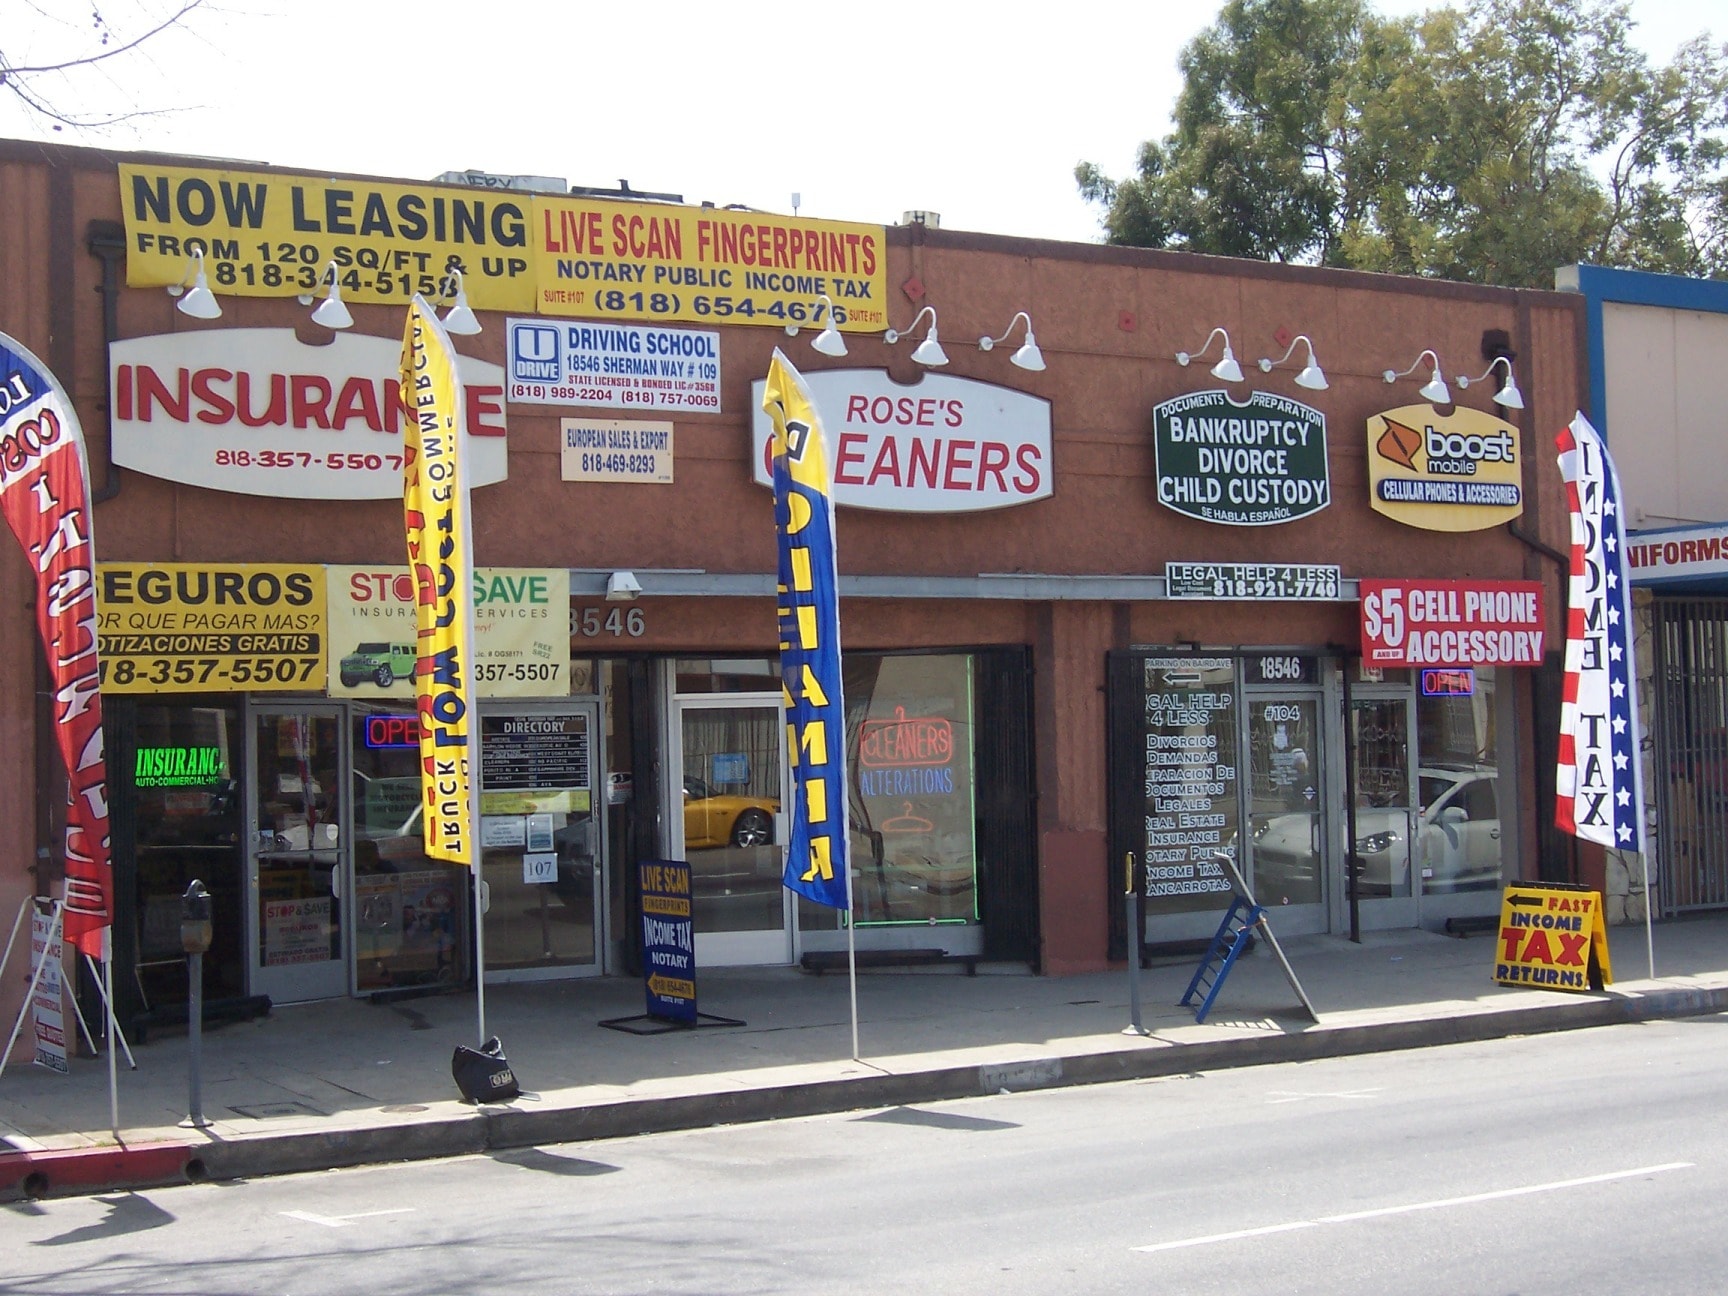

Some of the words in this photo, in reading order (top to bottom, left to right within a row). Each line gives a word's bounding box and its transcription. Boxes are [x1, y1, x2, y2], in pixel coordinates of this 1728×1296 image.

[131, 175, 268, 229] NOW
[291, 185, 527, 247] LEASING
[544, 209, 604, 256] LIVE
[612, 213, 682, 261] SCAN
[697, 219, 877, 276] FINGERPRINTS
[137, 233, 241, 260] FROM
[257, 242, 320, 264] 120
[334, 246, 432, 272] SQ/FT
[445, 254, 467, 275] &
[482, 257, 528, 278] UP
[215, 262, 458, 297] 818-344-5158
[557, 259, 646, 283] NOTARY
[655, 266, 733, 289] PUBLIC
[745, 271, 826, 296] INCOME
[832, 278, 872, 299] TAX
[543, 289, 566, 303] SUITE
[567, 290, 585, 305] #107
[594, 289, 681, 314] (818)
[693, 295, 847, 325] 654-4676
[848, 309, 867, 322] SUITE
[868, 311, 882, 324] #107
[568, 327, 641, 353] DRIVING
[646, 334, 716, 357] SCHOOL
[516, 360, 559, 379] DRIVE
[567, 354, 600, 372] 18546
[603, 357, 657, 376] SHERMAN
[660, 360, 684, 378] WAY
[699, 363, 717, 379] 109
[568, 375, 593, 385] STATE
[594, 376, 631, 387] LICENSED
[641, 378, 672, 389] BONDED
[117, 364, 507, 437] INSURAE
[511, 384, 546, 399] (818)
[551, 386, 613, 401] 989-2204
[621, 390, 655, 405] (818)
[660, 393, 718, 407] 757-0069
[846, 395, 963, 427] ROSE'S
[1161, 393, 1225, 418] DOCUMENTS
[1253, 395, 1322, 427] PREPARATION
[567, 428, 607, 448] EUROPEAN
[608, 430, 631, 449] SALES
[640, 431, 668, 450] EXPORT
[1170, 416, 1310, 446] BANKRUPTCY
[1425, 426, 1515, 463] boost
[215, 450, 403, 471] 818-357-5507
[582, 453, 655, 473] 818-469-8293
[764, 432, 1042, 494] EANERS
[1198, 447, 1288, 475] DIVORCE
[1428, 460, 1476, 474] mobile
[1159, 476, 1222, 504] CHILD
[1228, 478, 1325, 505] CUSTODY
[1383, 480, 1424, 500] CELLULAR
[1425, 482, 1457, 501] PHONES
[1466, 484, 1518, 504] ACCESSORIES
[1201, 506, 1212, 518] SE
[1213, 508, 1248, 522] HABLA
[1250, 506, 1291, 522] ESPAÑOL
[1626, 536, 1728, 568] NIFORMS
[1172, 566, 1228, 580] LEGAL
[1234, 568, 1276, 581] HELP
[1281, 569, 1291, 581] 4
[1297, 569, 1336, 582] LESS
[96, 571, 313, 605] EGUROS
[1213, 581, 1336, 597] 818-921-7740
[96, 613, 121, 629] OR
[128, 613, 177, 629] QUE
[183, 614, 256, 630] PAGAR
[263, 614, 320, 630] MAS?
[476, 609, 548, 618] ERVICES
[1364, 588, 1404, 647] $5
[1408, 590, 1461, 622] CELL
[1465, 591, 1537, 623] PHONE
[97, 635, 231, 653] OTIZACIONES
[237, 635, 310, 651] GRATIS
[533, 641, 552, 652] FREE
[1406, 630, 1543, 663] ACCESSORY
[98, 658, 319, 685] 18-357-5507
[475, 664, 560, 681] 357-5507
[1145, 658, 1178, 668] PARKING
[1180, 658, 1191, 667] ON
[1216, 658, 1231, 667] AVE
[1260, 657, 1300, 679] 18546
[1425, 672, 1471, 693] OPEN
[1189, 693, 1232, 709] HELP
[1151, 711, 1163, 726] 4
[1168, 710, 1210, 726] LESS
[1264, 706, 1299, 721] #104
[369, 719, 420, 744] OPE
[503, 721, 565, 733] DIRECTORY
[862, 724, 949, 760] CLEANERS
[1147, 734, 1216, 748] DIVORCIOS
[135, 747, 223, 776] INSURANC
[1147, 751, 1217, 765] DEMANDAS
[861, 768, 953, 796] ALTERATIONS
[1155, 798, 1211, 812] LEGALES
[1179, 813, 1225, 829] ESTATE
[1148, 831, 1219, 846] INSURANCE
[1146, 849, 1187, 863] OTARY
[527, 861, 552, 876] 107
[1197, 862, 1224, 876] TAX
[641, 865, 663, 892] LIVE
[664, 867, 689, 894] SCAN
[1146, 878, 1231, 896] ANCARROTAS
[644, 896, 689, 914] FINGERPRINTS
[1548, 897, 1592, 913] FAST
[1510, 911, 1582, 931] INCOME
[643, 915, 676, 948] INCOME
[676, 920, 692, 953] TAX
[1501, 927, 1588, 967] TAX
[651, 952, 688, 969] NOTARY
[1496, 964, 1584, 987] RETURNS
